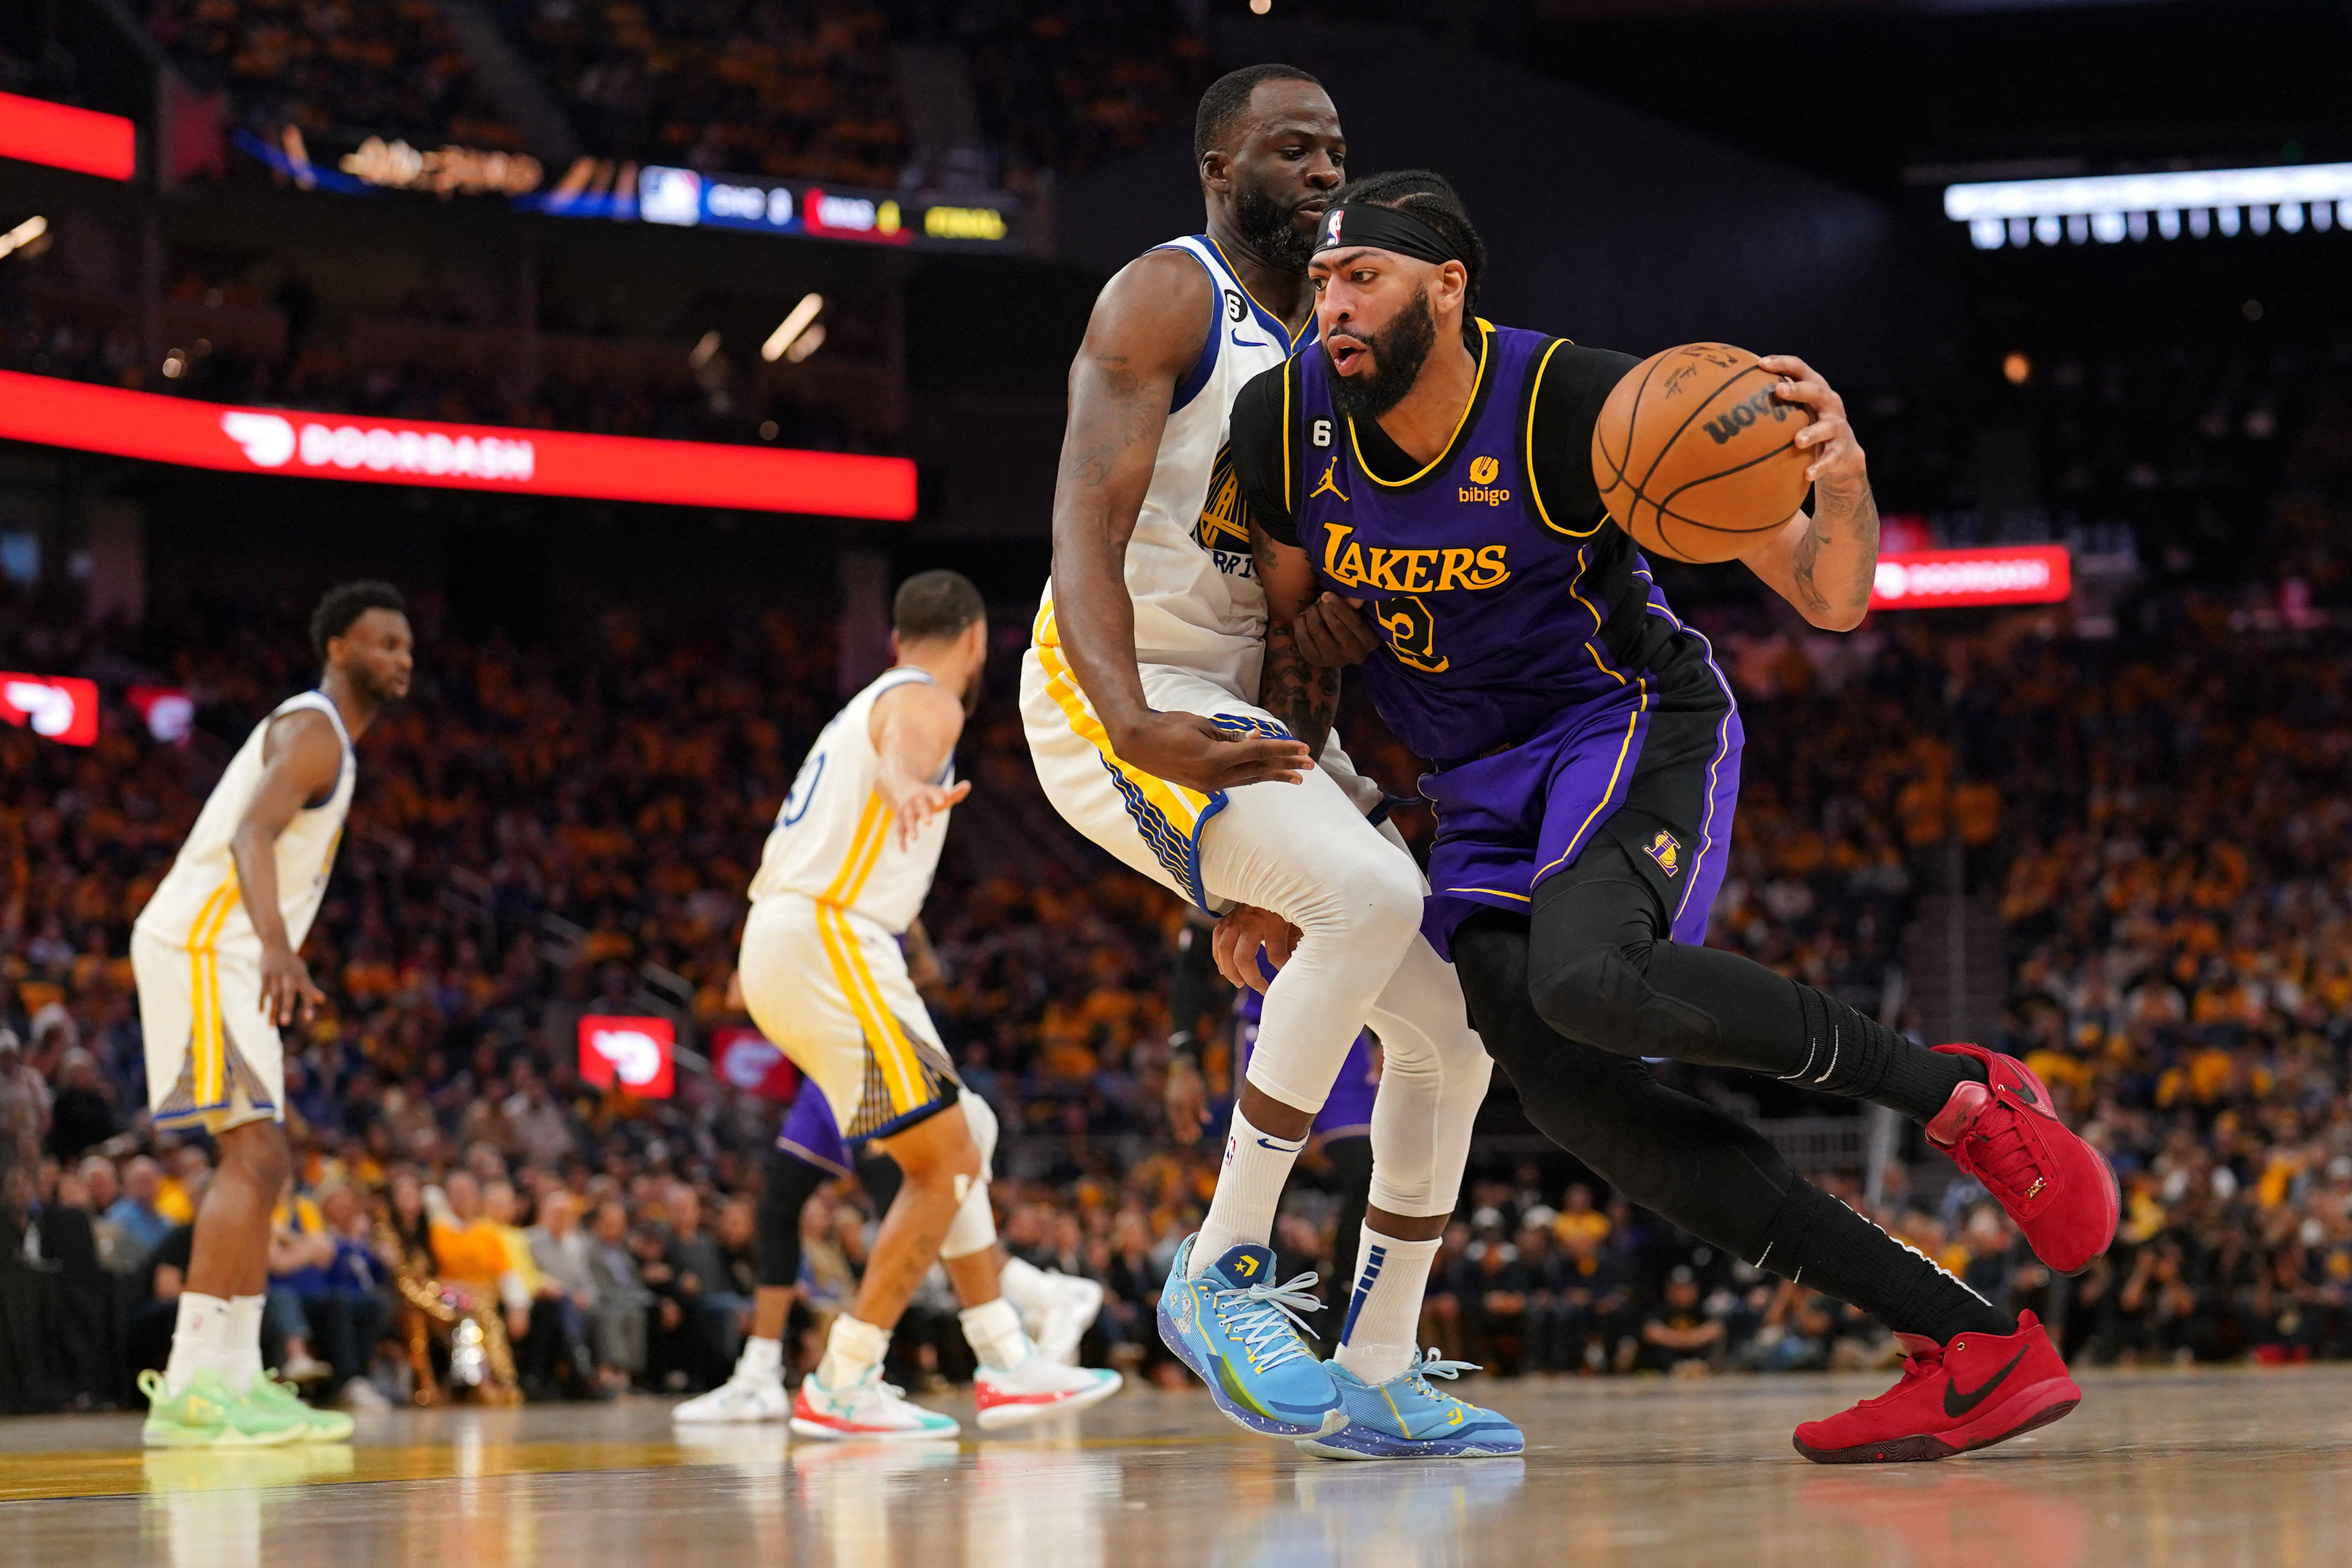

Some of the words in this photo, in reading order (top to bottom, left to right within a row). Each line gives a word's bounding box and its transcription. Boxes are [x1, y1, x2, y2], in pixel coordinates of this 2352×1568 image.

[1227, 293, 1241, 319] 6
[1312, 420, 1332, 447] 6
[1458, 486, 1510, 507] bibigo
[1322, 521, 1511, 593] LAKERS
